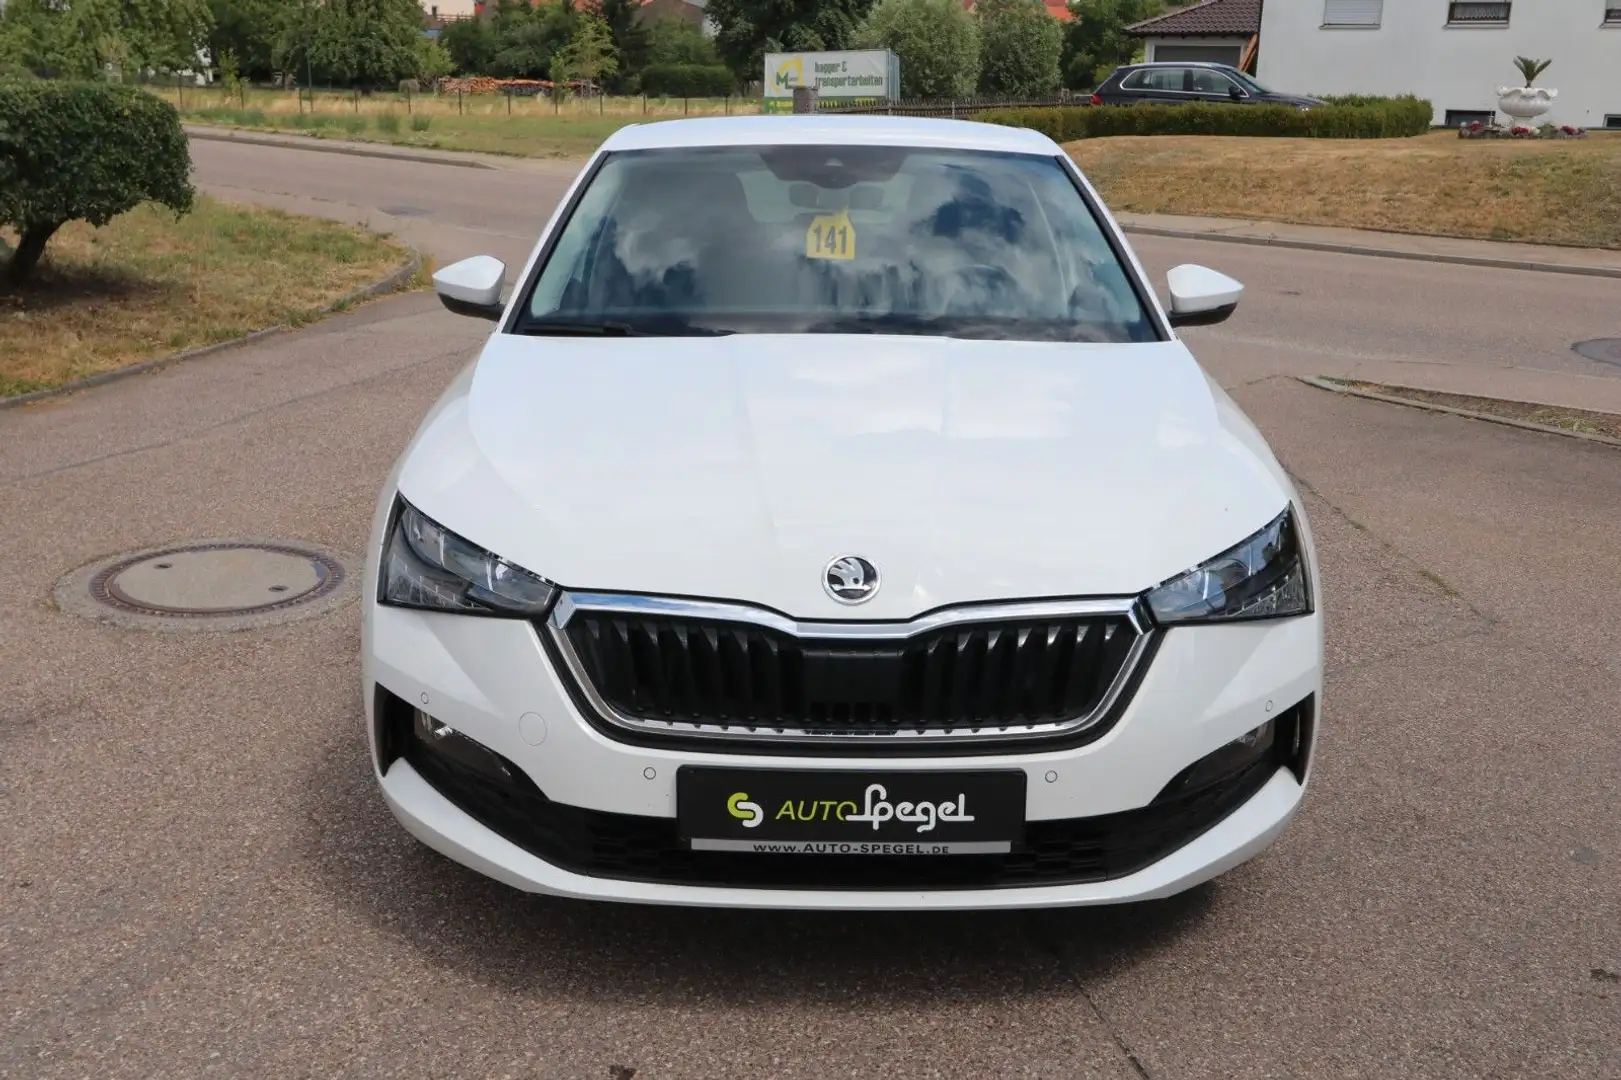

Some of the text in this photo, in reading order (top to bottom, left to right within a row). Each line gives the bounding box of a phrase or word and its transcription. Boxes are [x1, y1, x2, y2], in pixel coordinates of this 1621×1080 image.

[812, 225, 848, 255] 141
[775, 783, 976, 833] AUTO Spegel
